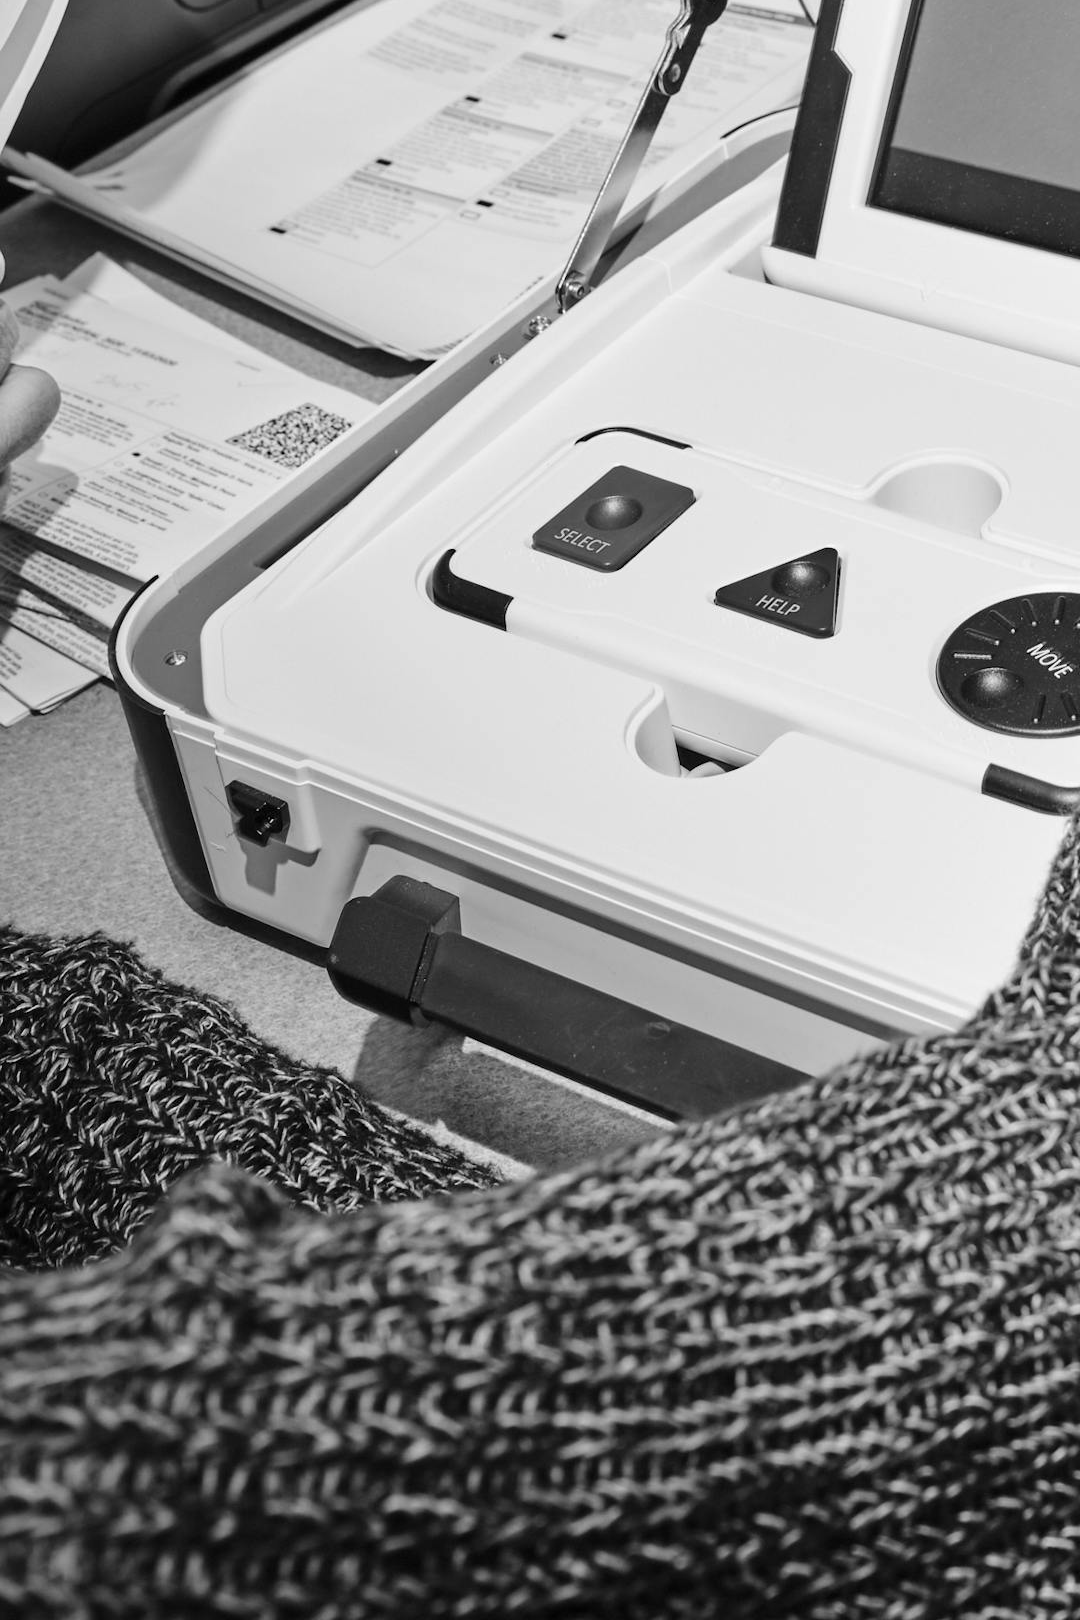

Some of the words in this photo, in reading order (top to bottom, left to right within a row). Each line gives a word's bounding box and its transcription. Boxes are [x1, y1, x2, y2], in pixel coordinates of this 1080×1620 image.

[554, 527, 611, 554] SELECT
[755, 594, 801, 616] HELP
[1026, 643, 1074, 679] MOVE
